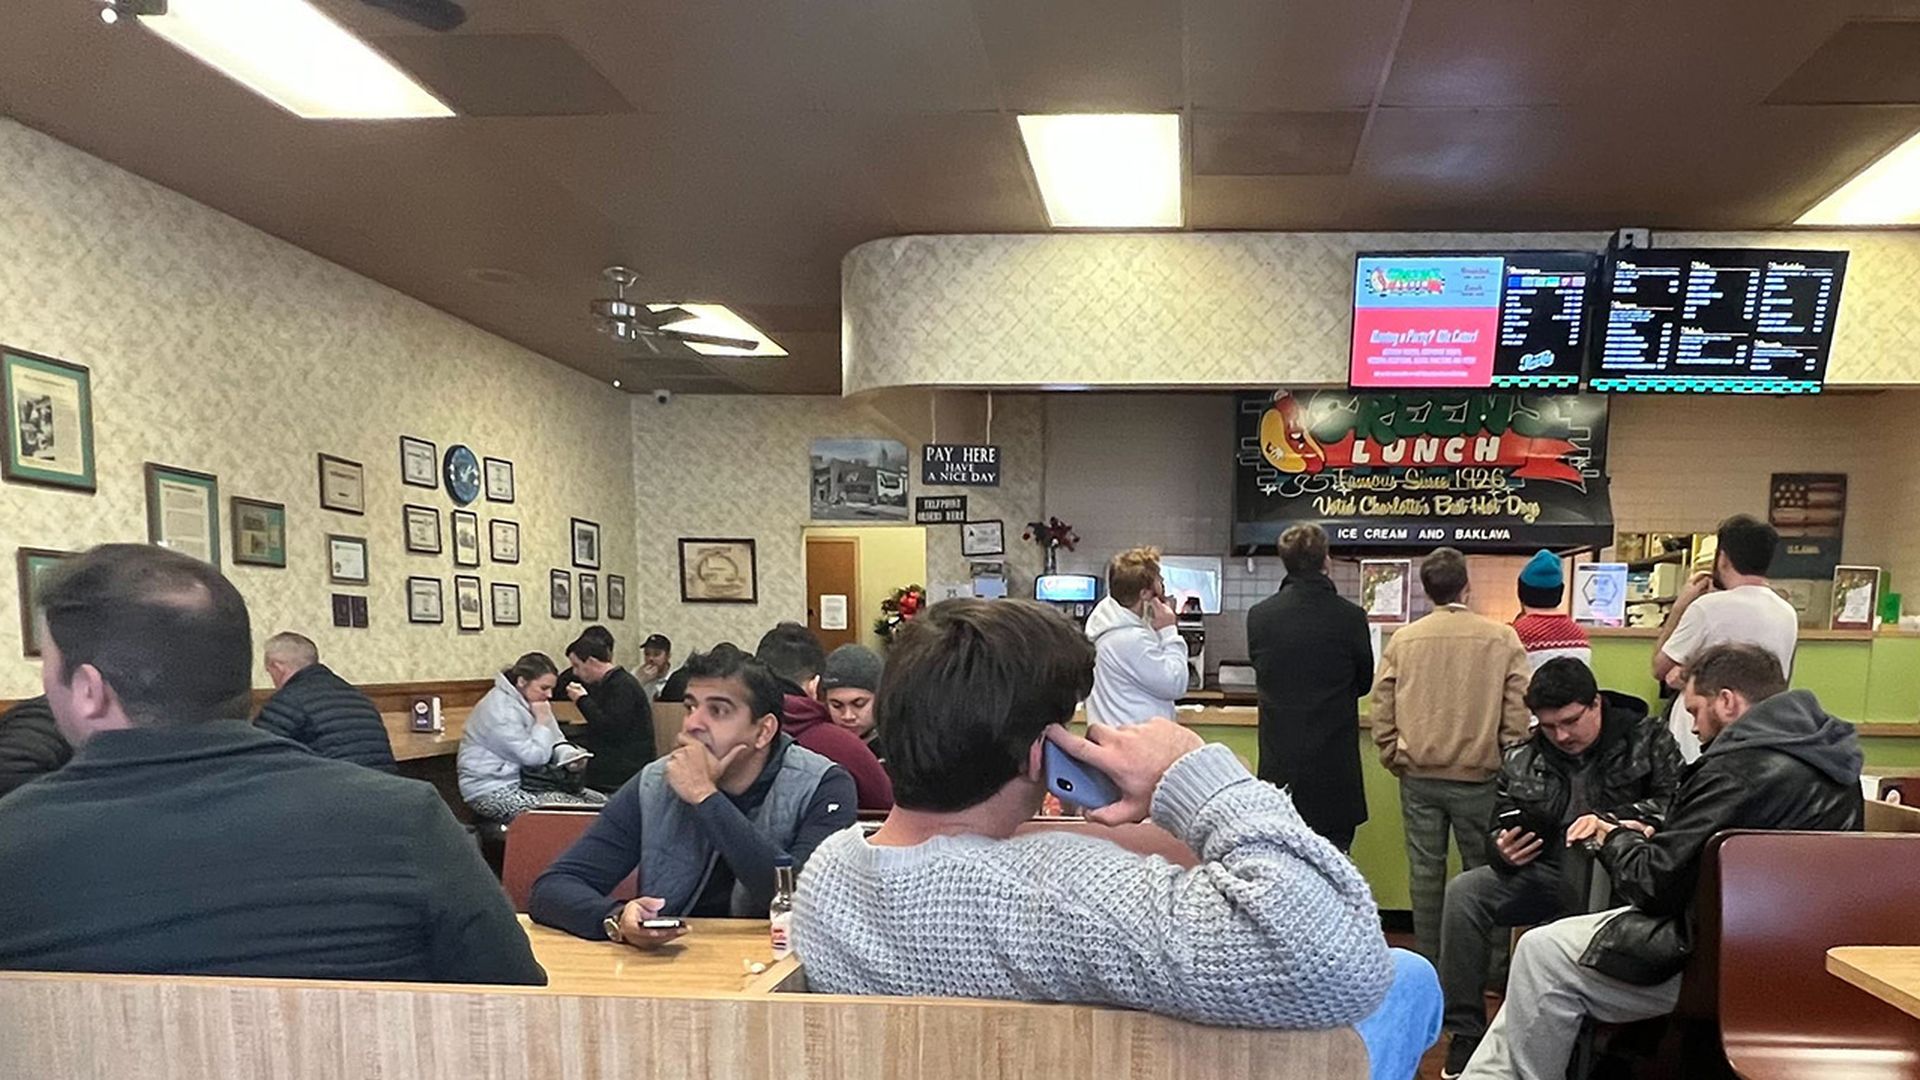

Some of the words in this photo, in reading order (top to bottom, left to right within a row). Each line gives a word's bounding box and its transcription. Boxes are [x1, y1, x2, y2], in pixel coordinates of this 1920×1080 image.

[927, 447, 953, 461] PAY
[964, 448, 995, 463] HERE
[1352, 436, 1501, 464] LUNCH
[945, 463, 973, 472] HAVE
[928, 472, 936, 481] A
[940, 472, 966, 481] NICE
[971, 473, 996, 482] DAY
[1333, 468, 1396, 490] Famous
[1402, 468, 1449, 490] Since
[1455, 468, 1506, 490] 1926
[1312, 495, 1356, 516] Voted
[1359, 495, 1430, 516] Charlotte's
[1433, 495, 1469, 516] Best
[1469, 495, 1501, 516] Hot
[1338, 528, 1357, 539] ICE
[1364, 528, 1408, 539] CREAM
[1418, 528, 1445, 540] AND
[1455, 528, 1511, 540] BAKLAVA
